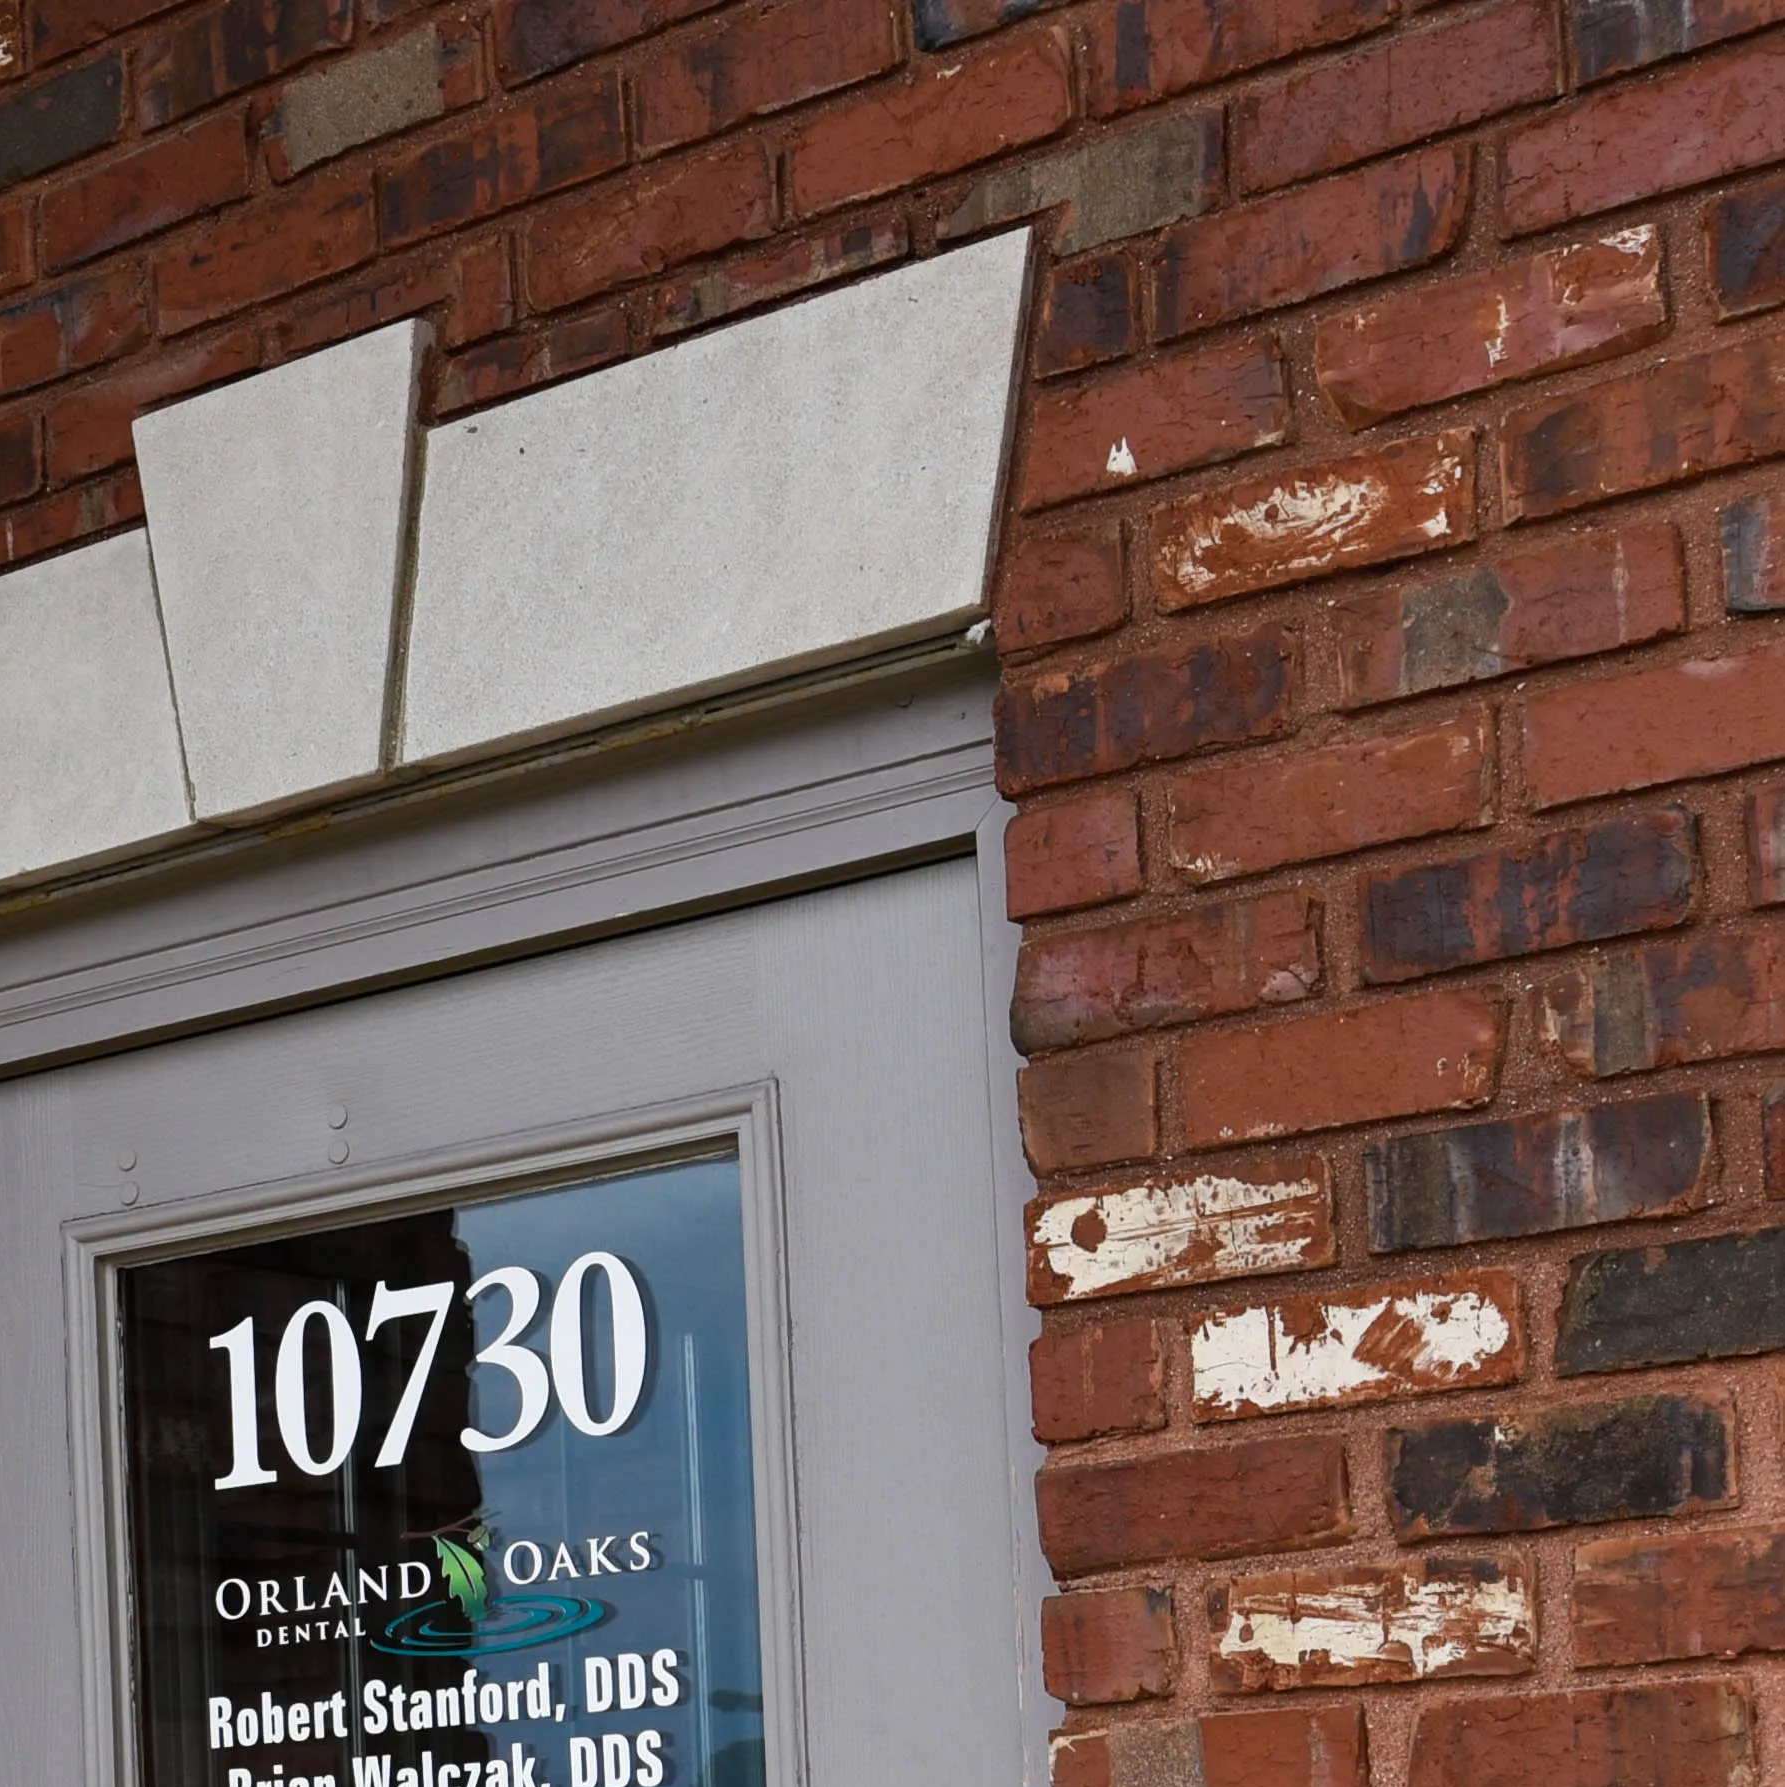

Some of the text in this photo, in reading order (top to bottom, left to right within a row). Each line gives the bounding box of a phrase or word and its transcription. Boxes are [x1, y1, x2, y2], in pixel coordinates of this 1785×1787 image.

[209, 1251, 647, 1490] 10730
[215, 1531, 652, 1620] ORLAND OAKS
[256, 1617, 367, 1648] DENTAL
[209, 1648, 680, 1750] Robert Stanford, DDS
